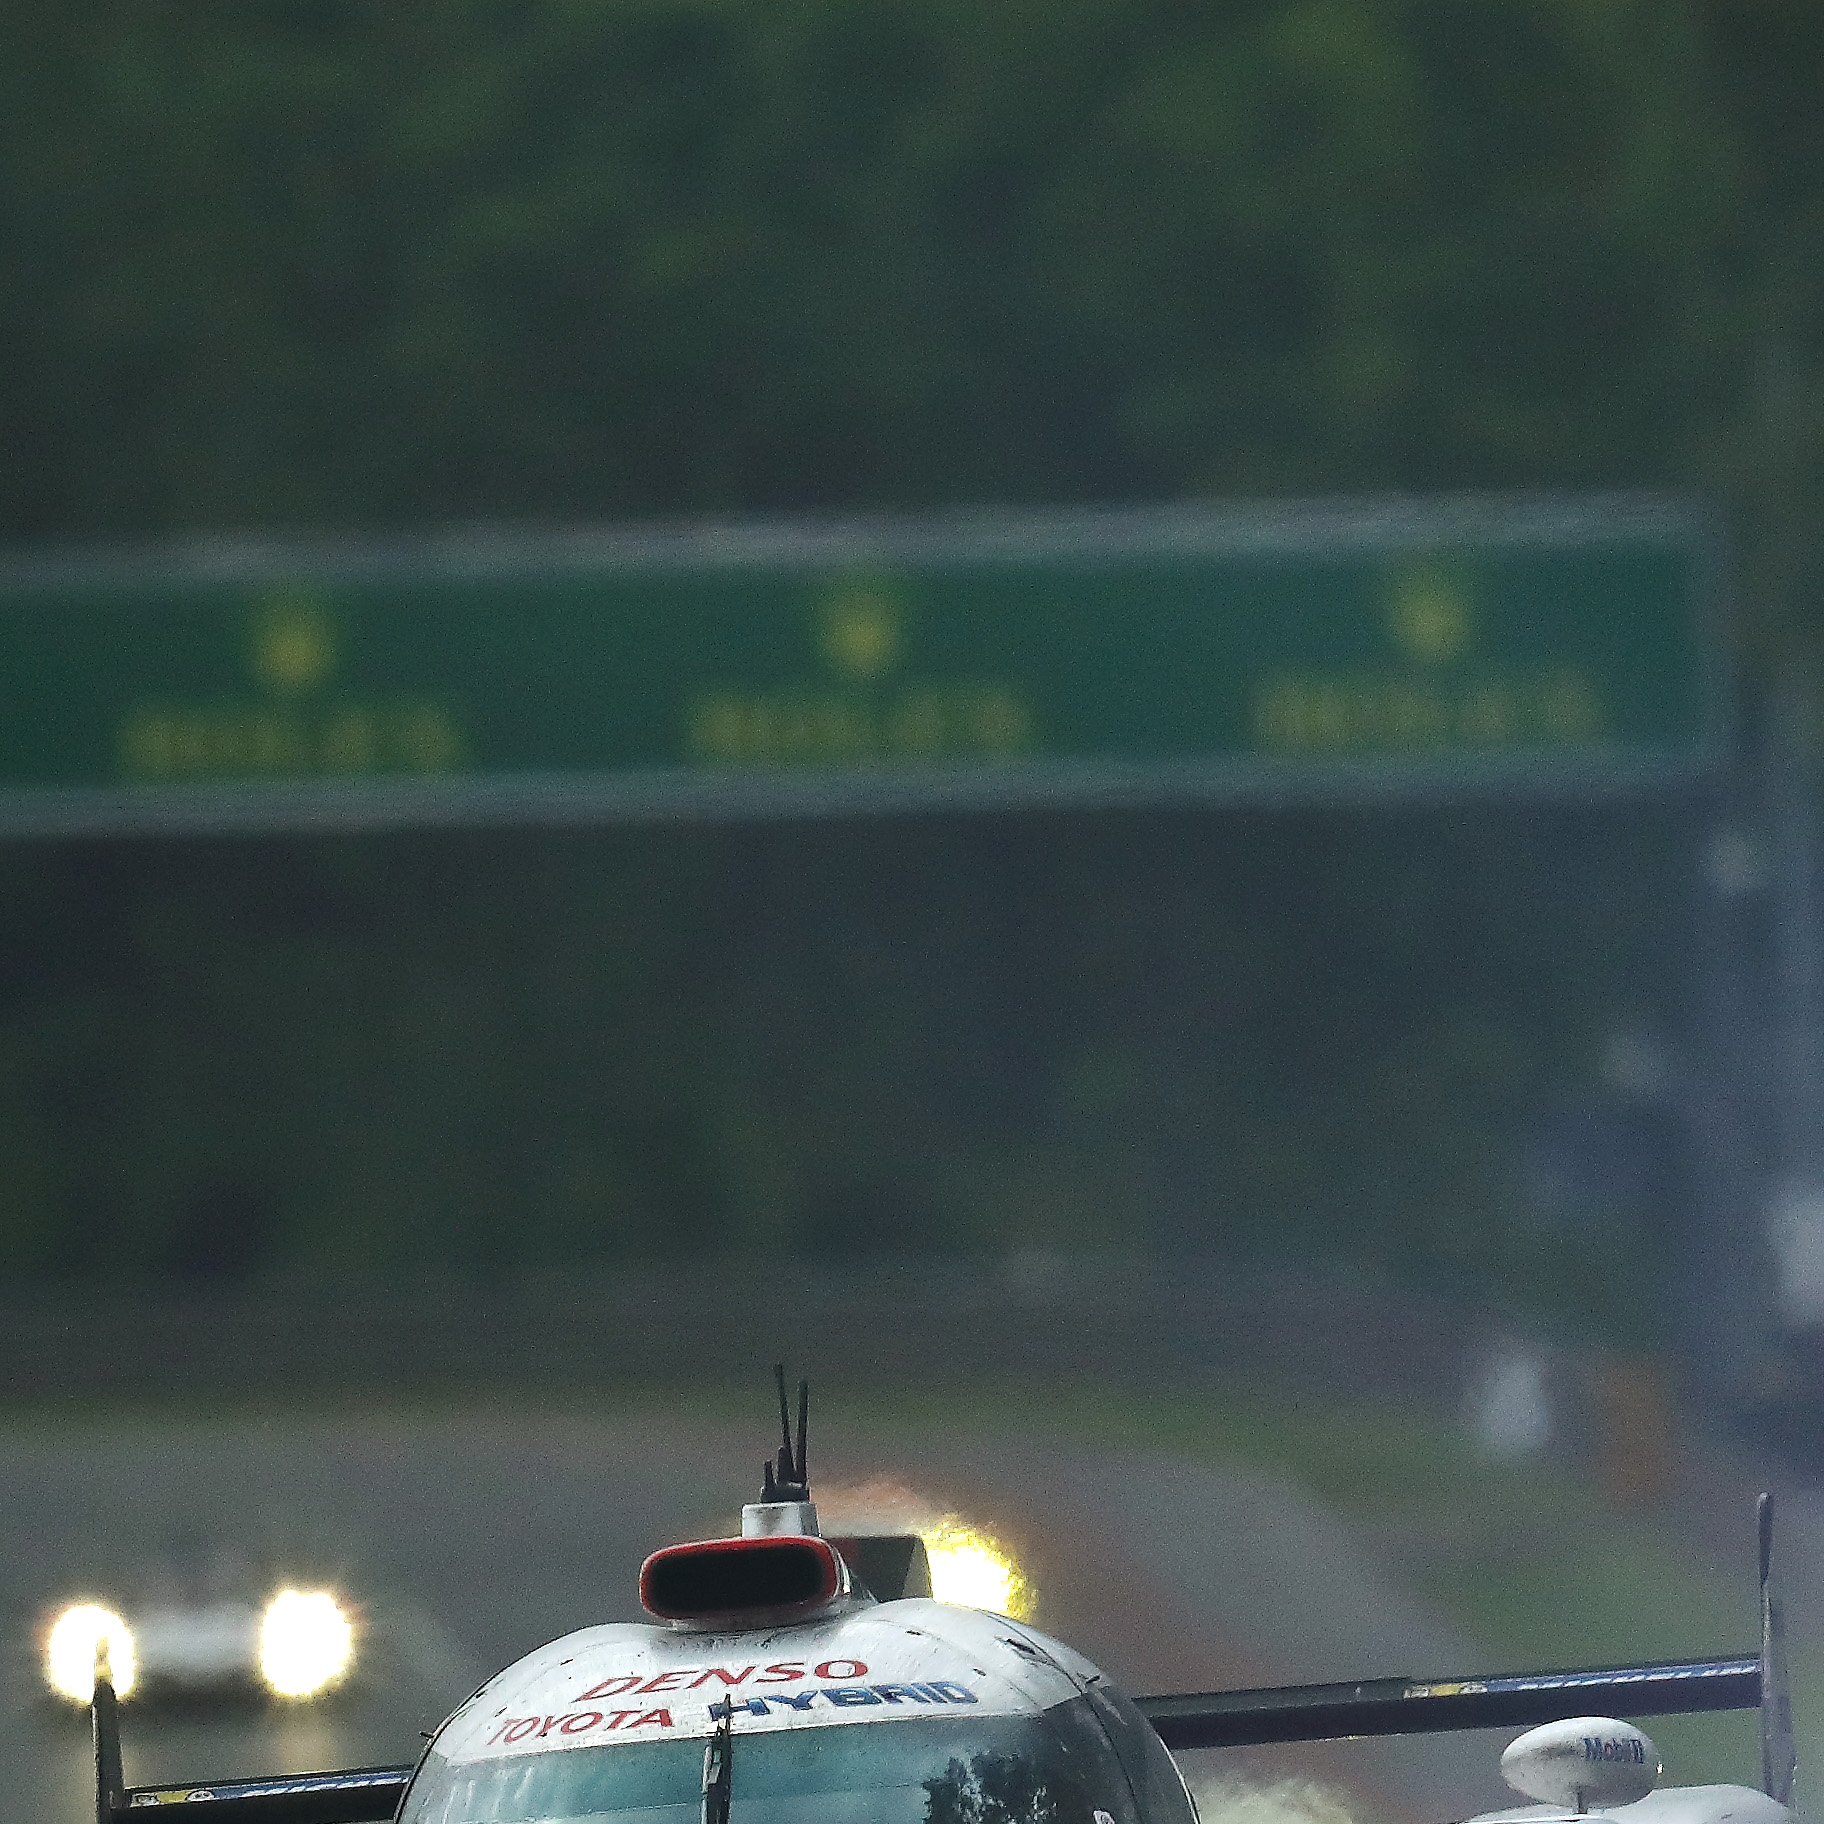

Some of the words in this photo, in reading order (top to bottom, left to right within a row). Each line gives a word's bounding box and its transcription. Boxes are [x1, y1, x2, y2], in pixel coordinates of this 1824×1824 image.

[571, 1659, 870, 1702] DENSO
[486, 1708, 674, 1746] TOYOTA
[708, 1680, 979, 1722] HYBRID
